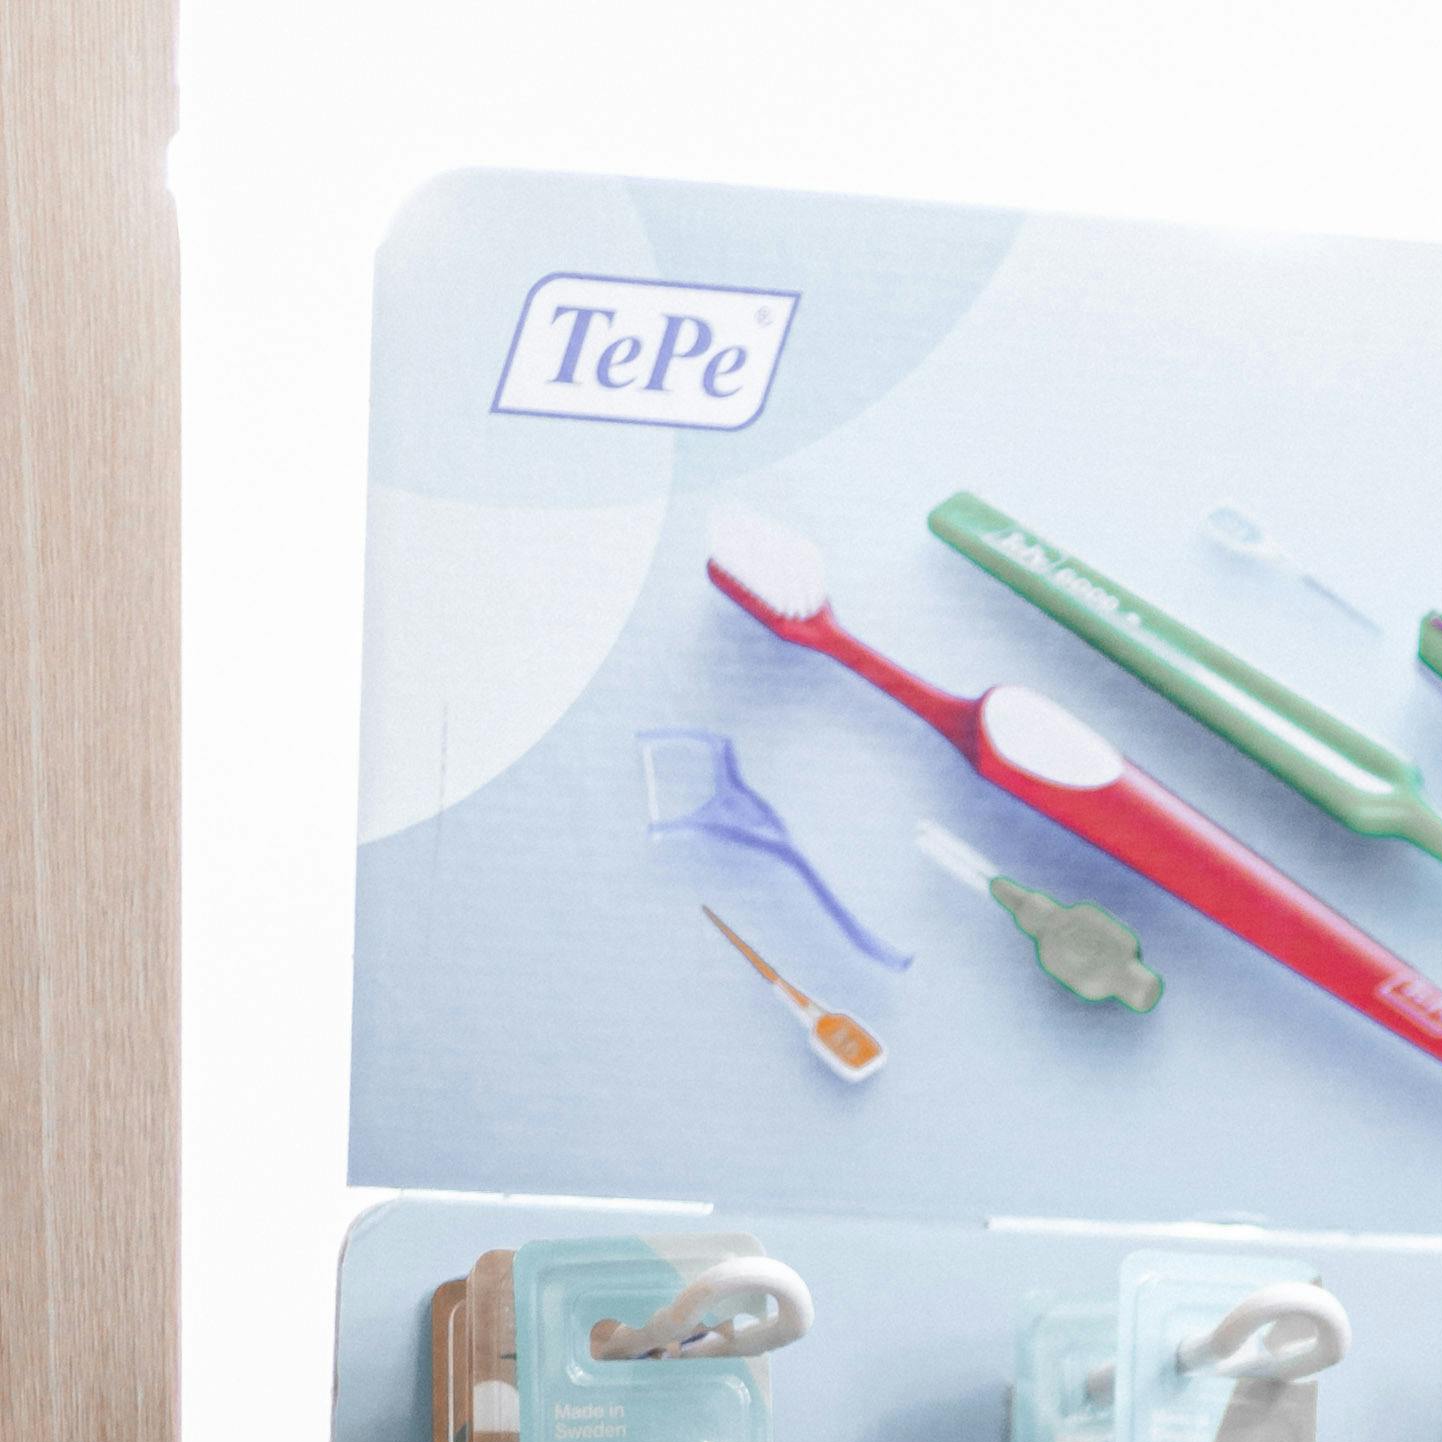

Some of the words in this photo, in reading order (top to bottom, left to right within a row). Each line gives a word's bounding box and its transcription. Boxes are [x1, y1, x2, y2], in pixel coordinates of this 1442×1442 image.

[547, 305, 750, 399] TePe
[554, 1402, 602, 1421] Made
[608, 1402, 625, 1421] in
[554, 1420, 627, 1440] Sweden
